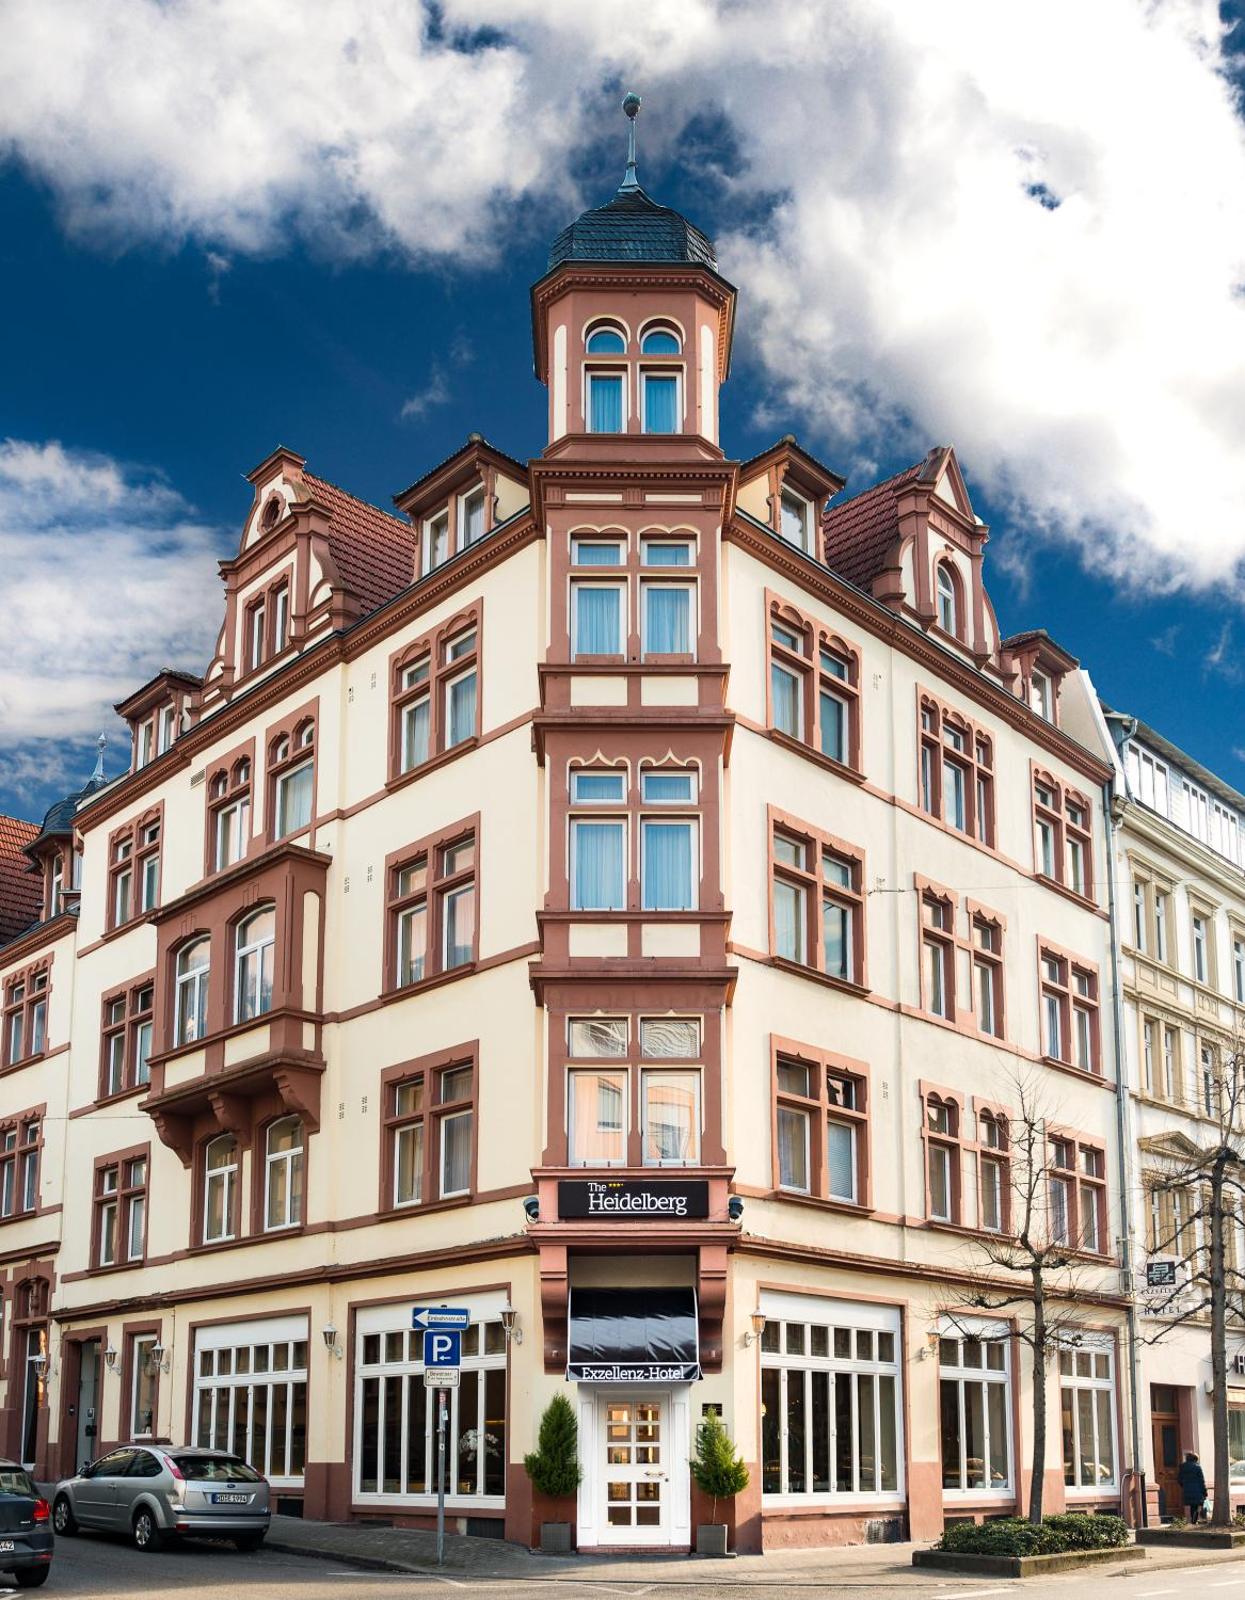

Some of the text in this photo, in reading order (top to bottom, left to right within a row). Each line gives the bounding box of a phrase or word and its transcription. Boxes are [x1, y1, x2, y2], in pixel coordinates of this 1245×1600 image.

[587, 1183, 607, 1192] The
[588, 1193, 688, 1216] Heidelberg
[433, 1335, 453, 1362] P
[582, 1366, 685, 1380] Exzellenz-Hotel
